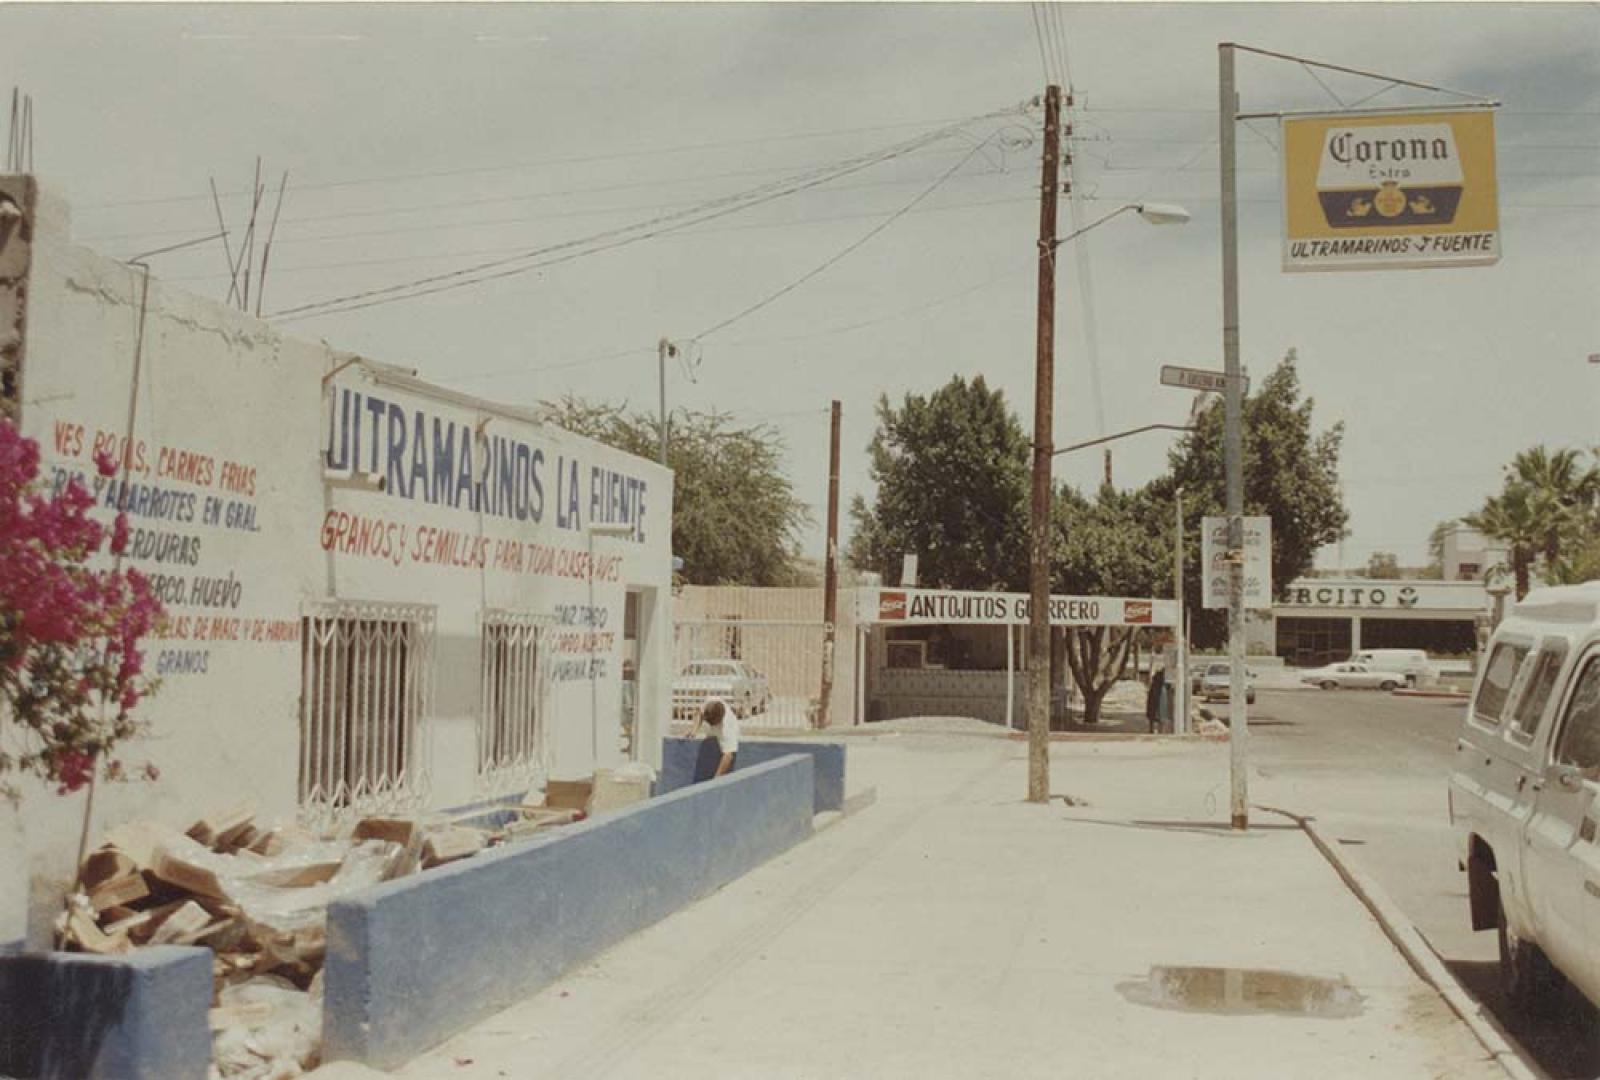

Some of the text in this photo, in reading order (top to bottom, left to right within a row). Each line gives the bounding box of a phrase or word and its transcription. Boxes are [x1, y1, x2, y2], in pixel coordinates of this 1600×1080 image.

[1329, 132, 1449, 163] Corona
[1290, 238, 1411, 259] ULTRAMARINOS
[1433, 233, 1493, 252] FUENTE
[556, 455, 581, 532] LA
[202, 495, 222, 526] EN
[121, 527, 201, 566] ERDURAS
[411, 526, 491, 569] SEMILLAS
[909, 594, 1007, 619] ANTOJITOS
[1014, 599, 1100, 620] GURRERO
[1280, 587, 1387, 604] ERCITO
